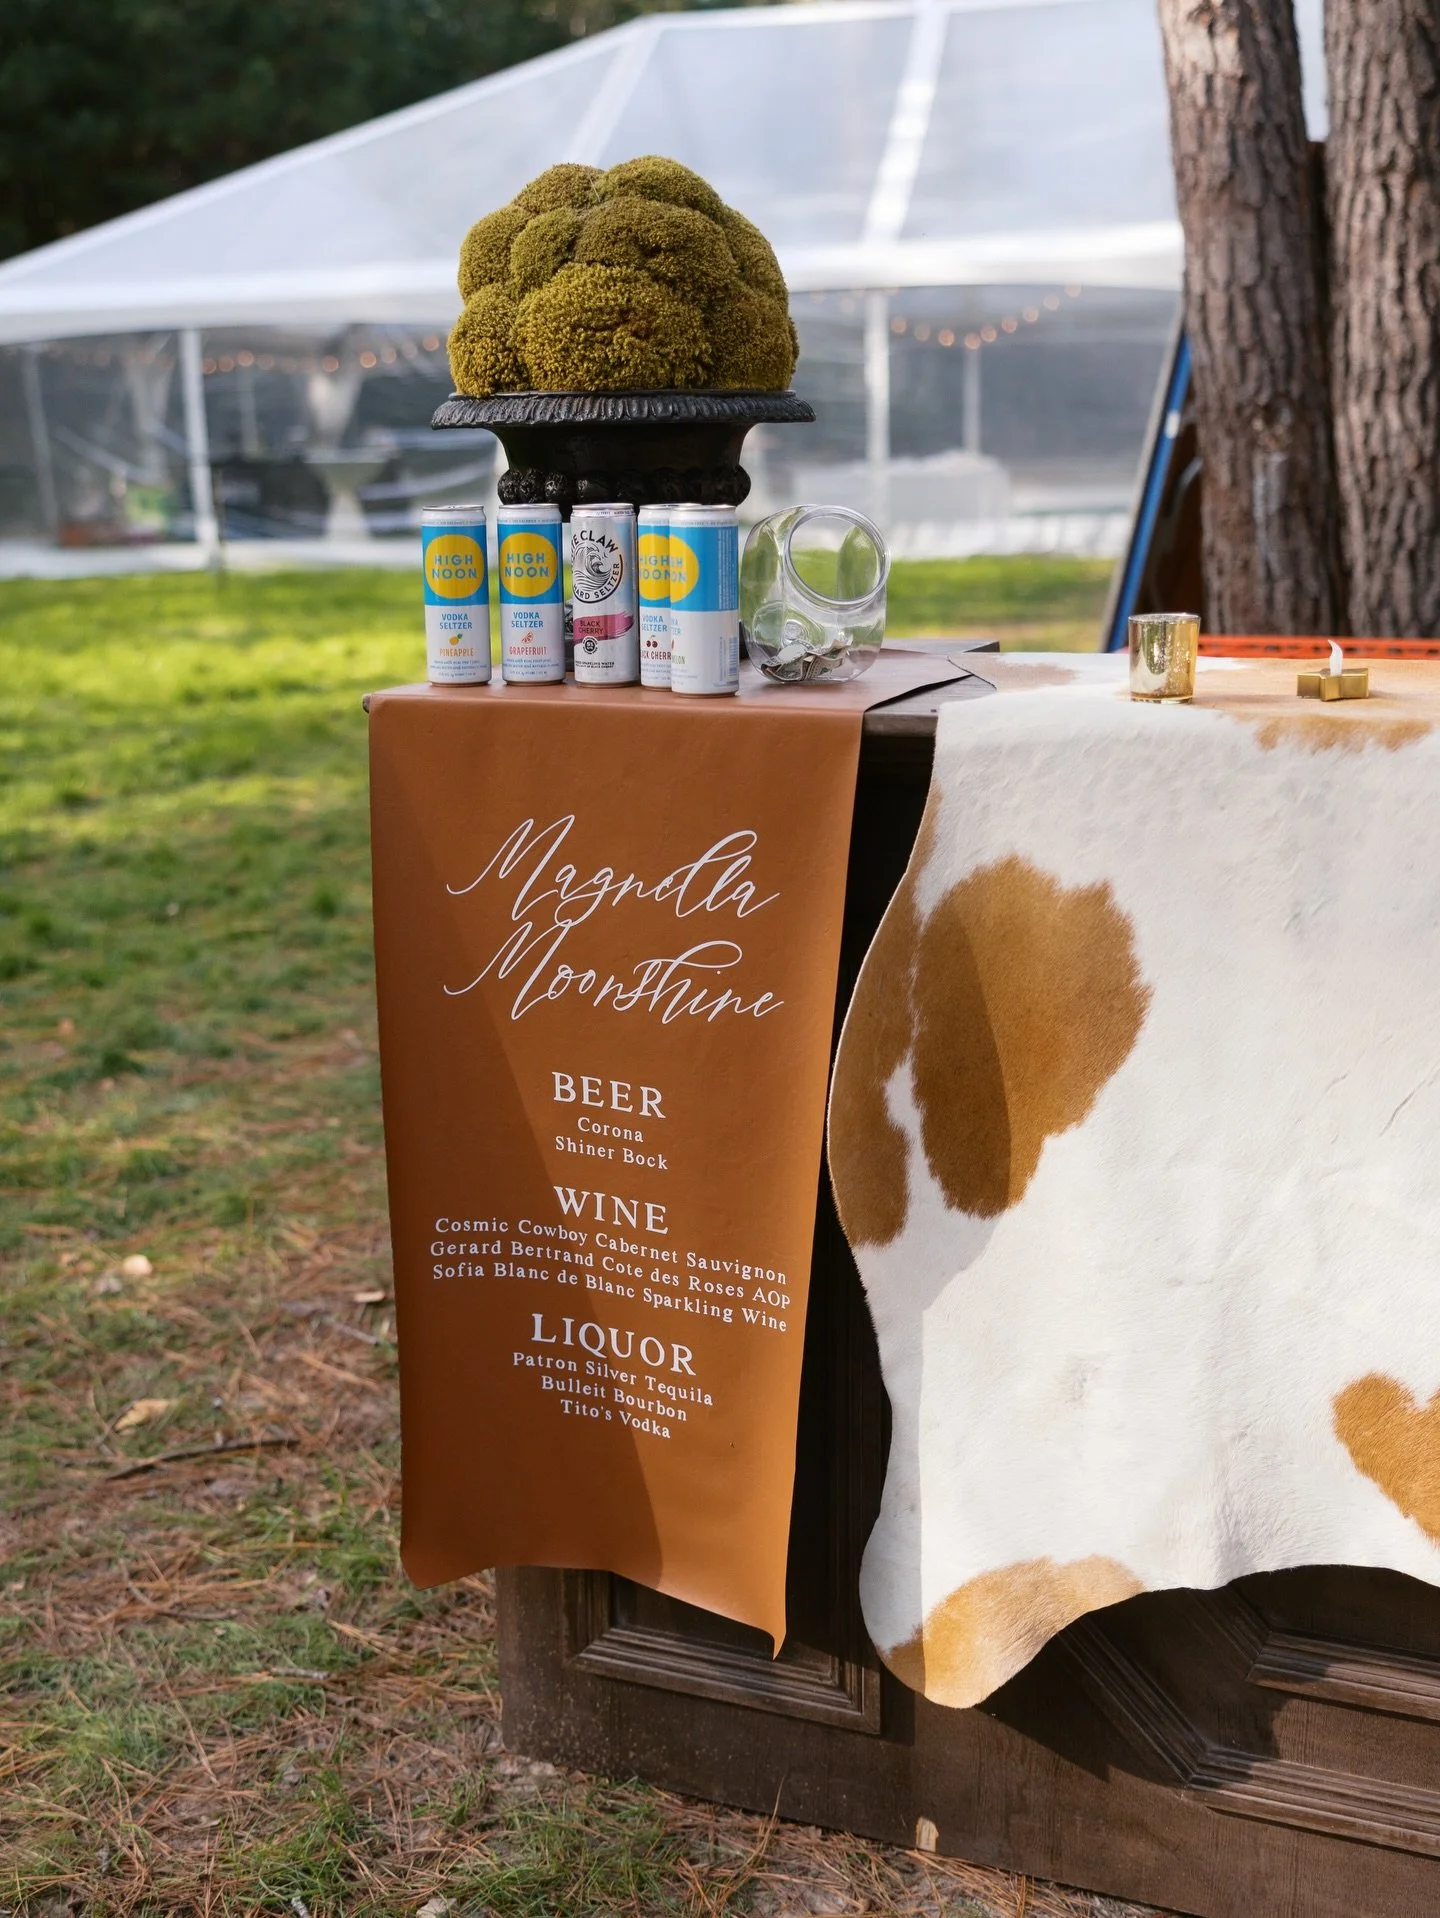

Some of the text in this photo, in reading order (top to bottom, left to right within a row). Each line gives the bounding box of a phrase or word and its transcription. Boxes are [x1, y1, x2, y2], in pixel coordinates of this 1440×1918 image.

[580, 530, 618, 552] CLAW
[434, 554, 473, 566] HIGH
[506, 552, 545, 564] HIGH
[432, 568, 478, 580] NOON
[504, 566, 550, 578] NOON
[594, 563, 620, 598] SELTZER
[440, 622, 473, 630] SELTZER
[441, 613, 468, 621] VODKA
[578, 626, 604, 634] CHERRY
[440, 648, 474, 656] PINEAPPLE
[509, 646, 547, 656] GRAPEFRUIT
[651, 651, 672, 660] CHERR
[552, 1071, 666, 1118] BEER
[577, 1116, 644, 1142] Corona
[555, 1136, 668, 1170] Shiner Bock
[554, 1186, 668, 1234] WINE
[435, 1218, 786, 1285] Cosmic Cowboy Cabernet Sauvignon
[430, 1240, 791, 1310] Gerard Bertrand Cote des Roses AOP
[433, 1262, 787, 1332] Sofia Blanc de Blanc Sparkling Wine
[532, 1313, 696, 1376] LIQUOR
[513, 1352, 713, 1406] Patron Silver Tequila
[541, 1376, 687, 1422] Bulleit Bourbon
[560, 1399, 671, 1439] Tito's Vodka
